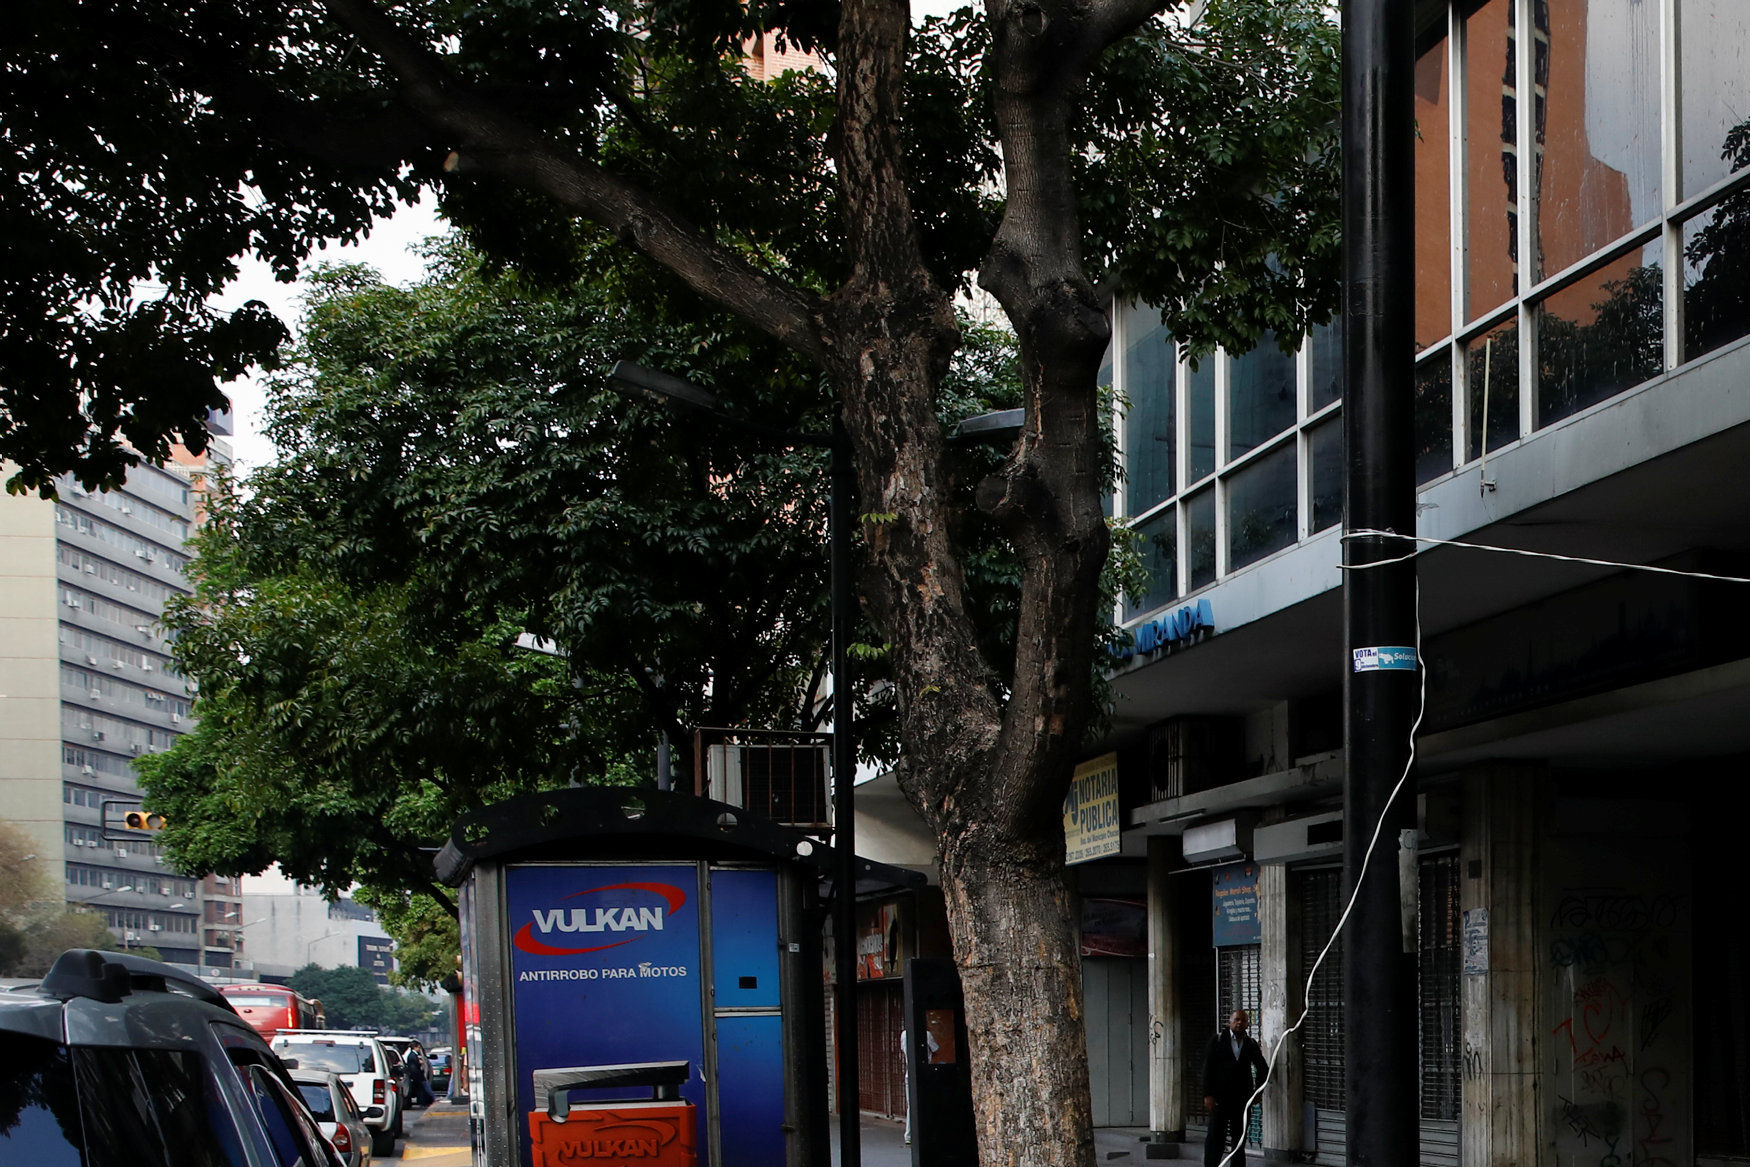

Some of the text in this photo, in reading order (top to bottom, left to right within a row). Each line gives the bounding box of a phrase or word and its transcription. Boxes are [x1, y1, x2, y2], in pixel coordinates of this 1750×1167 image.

[1135, 599, 1214, 653] MIRANDA
[1354, 649, 1372, 658] VOTA
[1079, 768, 1117, 804] NOTARIA
[1080, 799, 1119, 834] PUBLICA
[531, 907, 663, 934] VULKAN
[519, 965, 687, 982] ANTIRROBO PARA MOTOS
[560, 1138, 660, 1159] VULKAN
